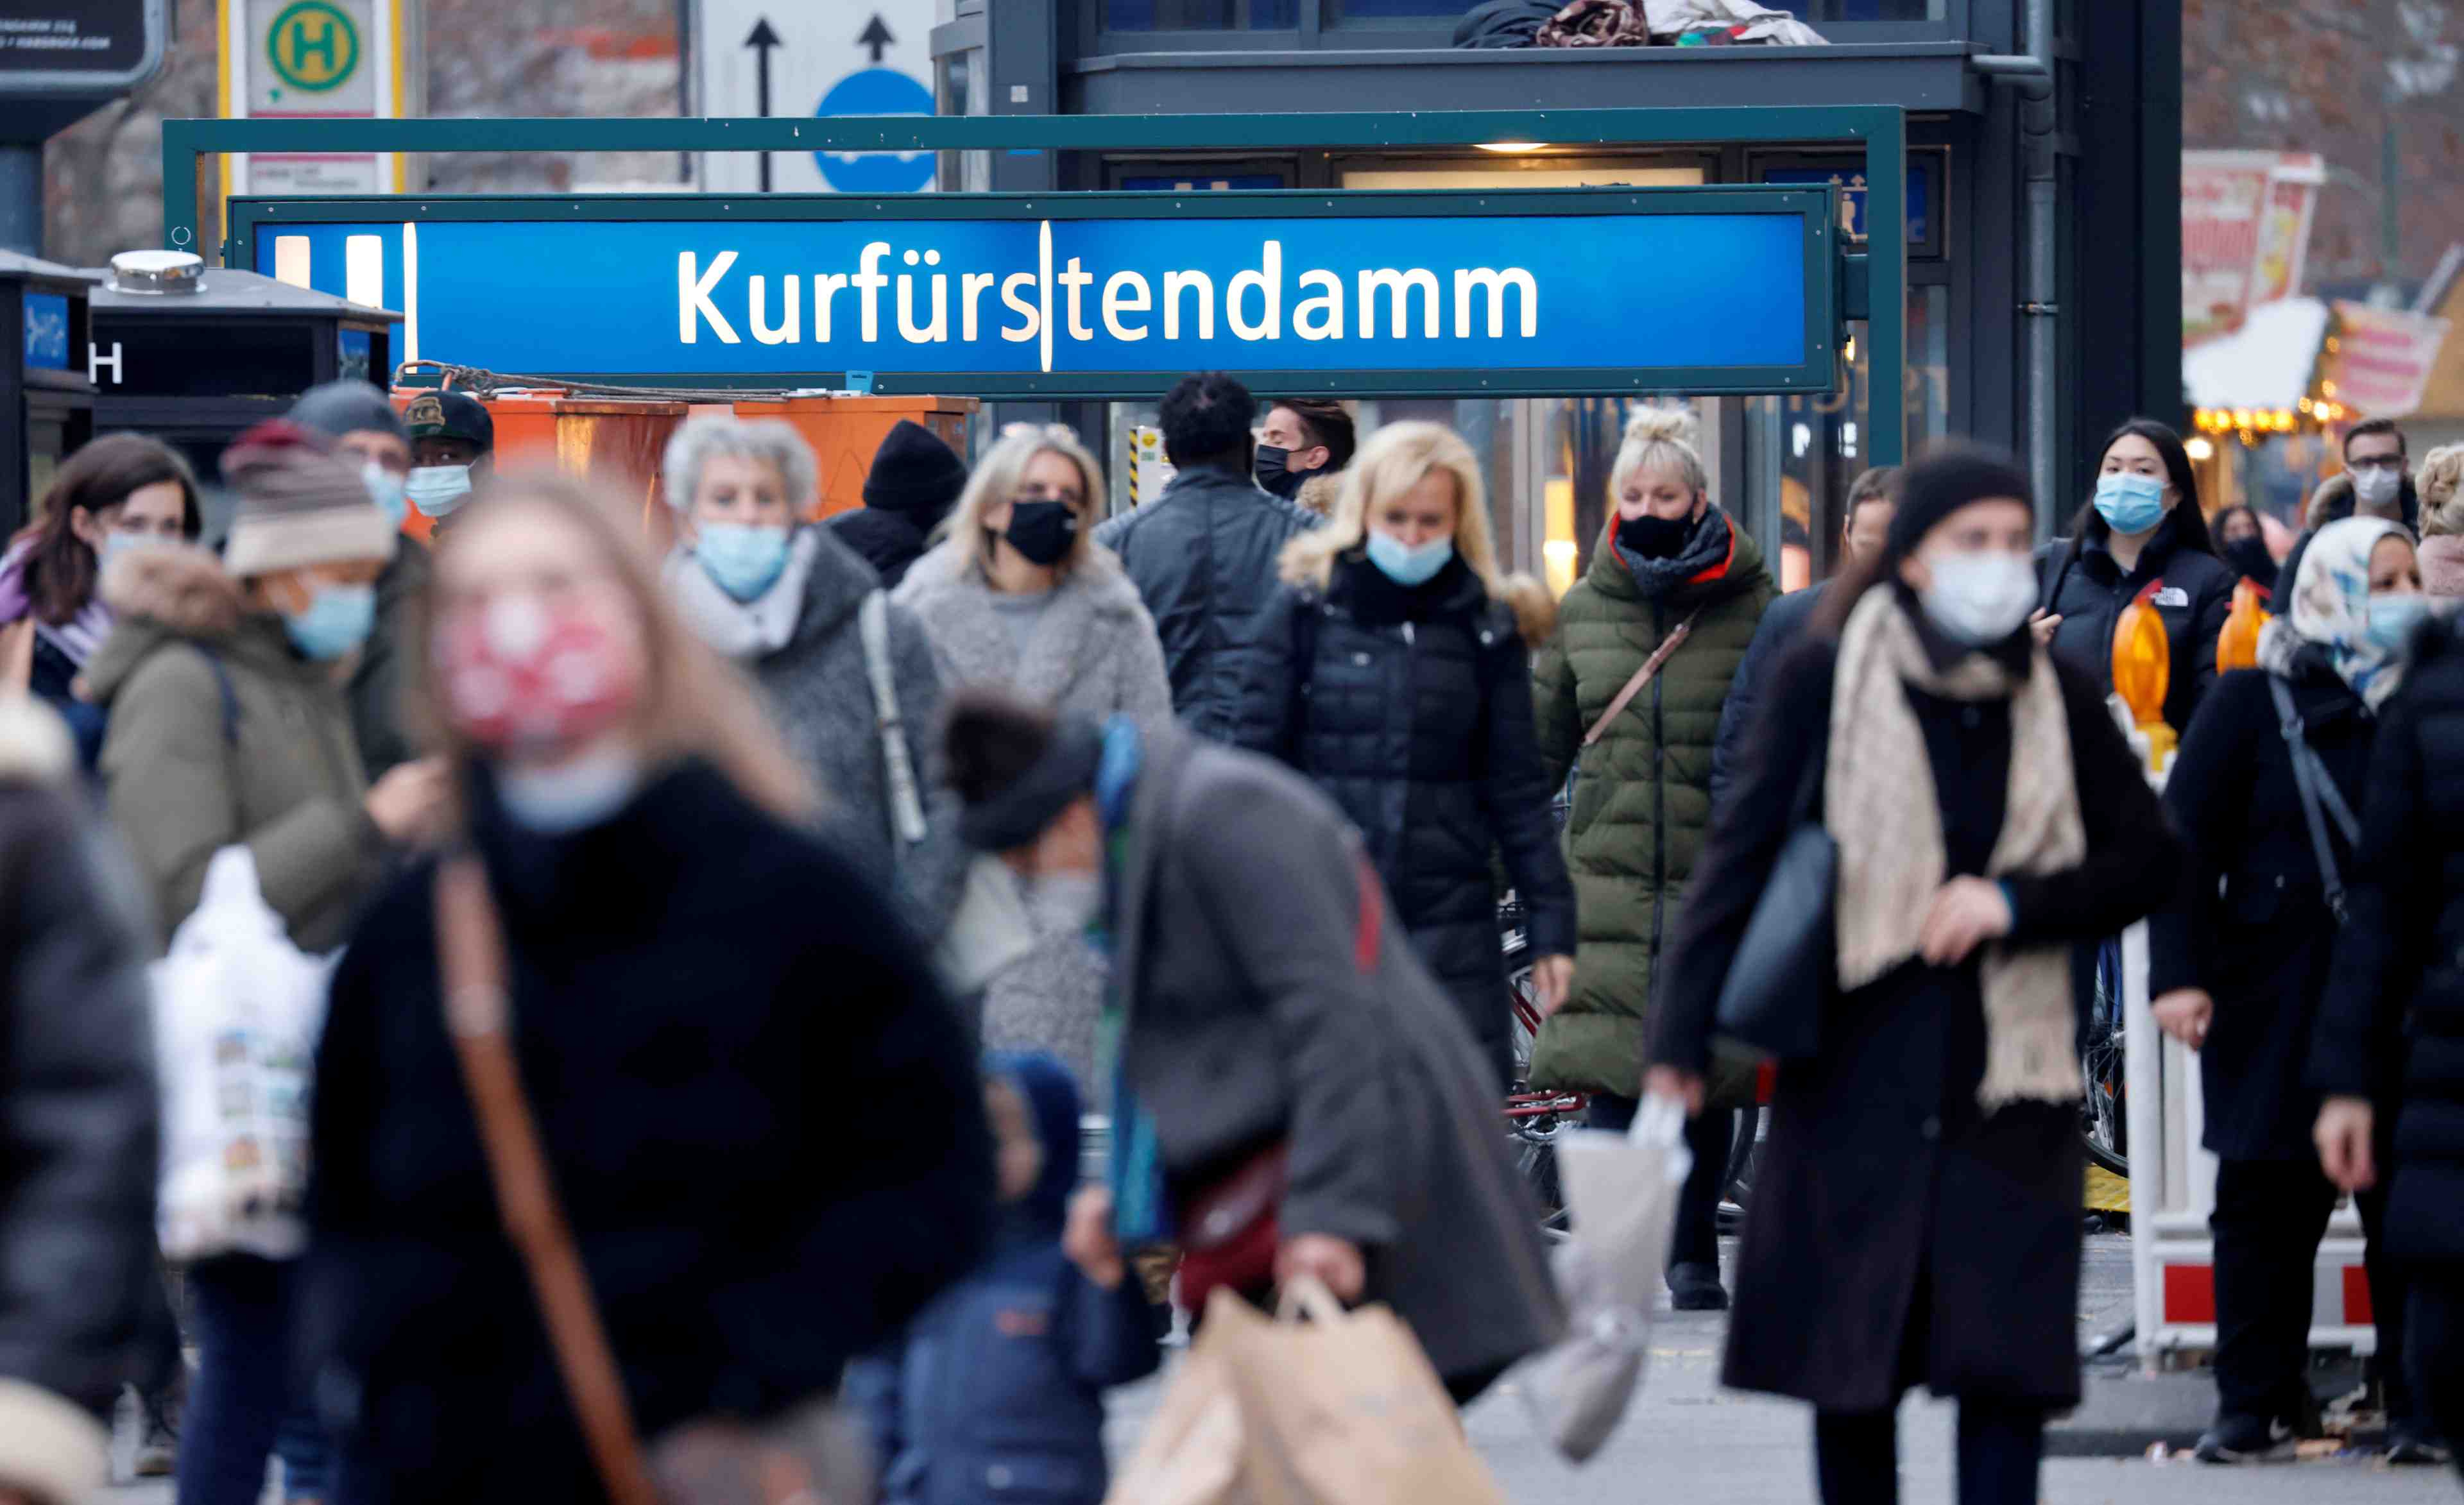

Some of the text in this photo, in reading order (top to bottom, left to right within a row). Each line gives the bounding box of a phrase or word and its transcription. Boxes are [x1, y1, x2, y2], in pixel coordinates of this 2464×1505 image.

[293, 22, 334, 71] H
[678, 240, 1537, 344] Kurfürstendamm
[89, 342, 122, 384] H
